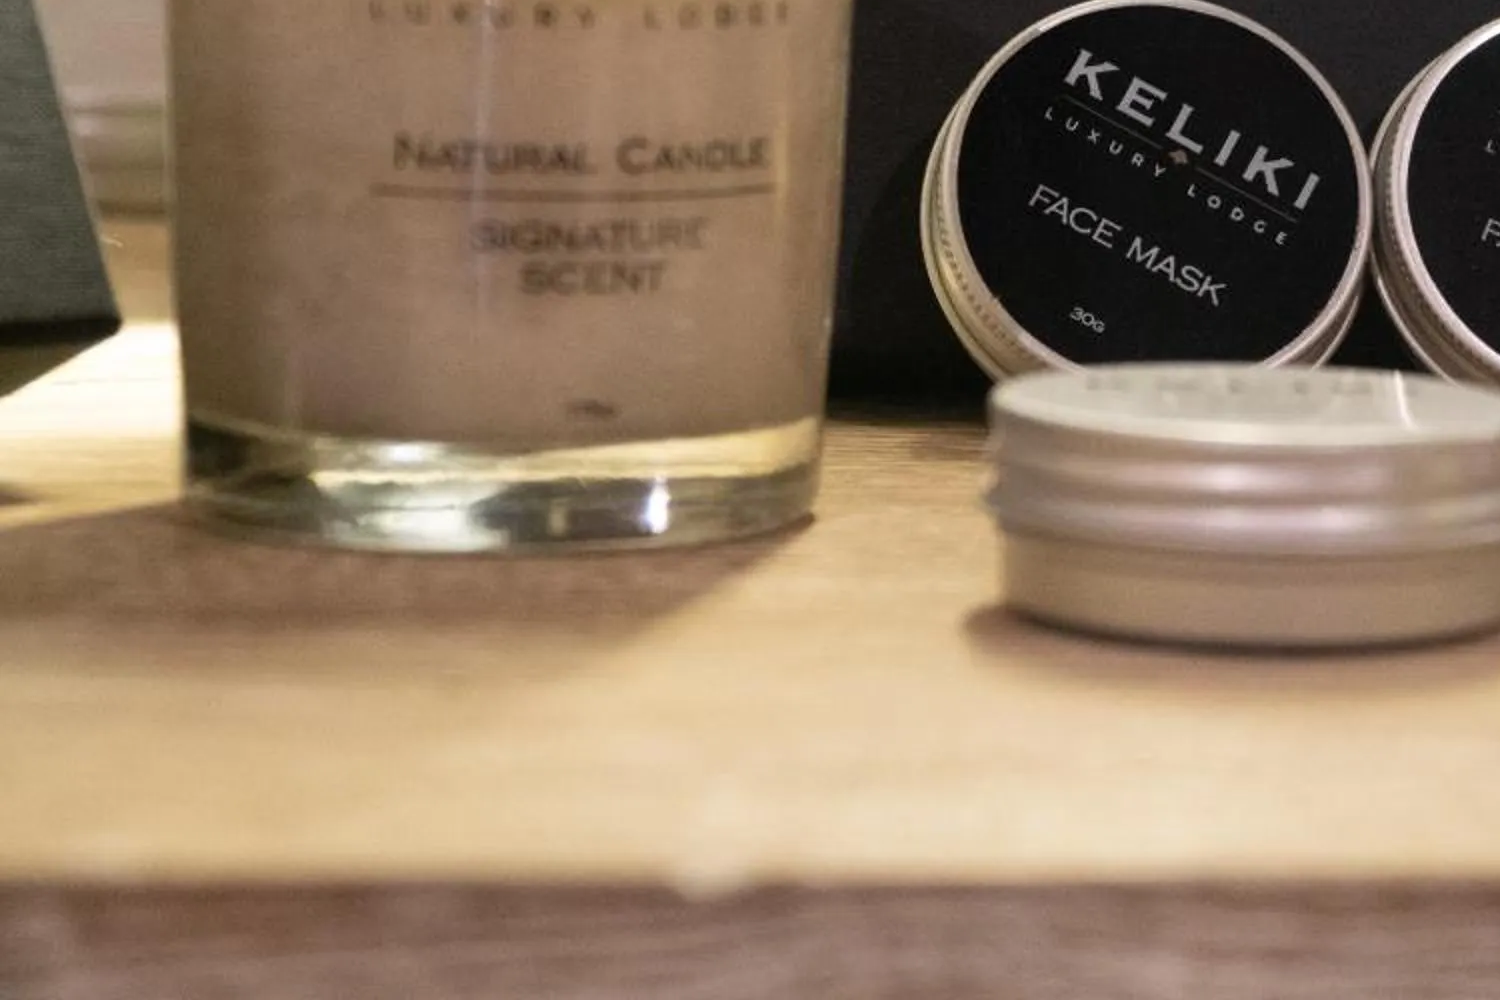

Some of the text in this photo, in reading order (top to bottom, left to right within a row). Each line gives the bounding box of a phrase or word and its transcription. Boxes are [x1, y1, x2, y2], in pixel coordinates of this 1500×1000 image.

[1044, 106, 1289, 246] LUXURY LODGE
[1064, 48, 1321, 210] KELIKI
[519, 261, 667, 295] SCENT
[1028, 184, 1228, 307] FACE MASK
